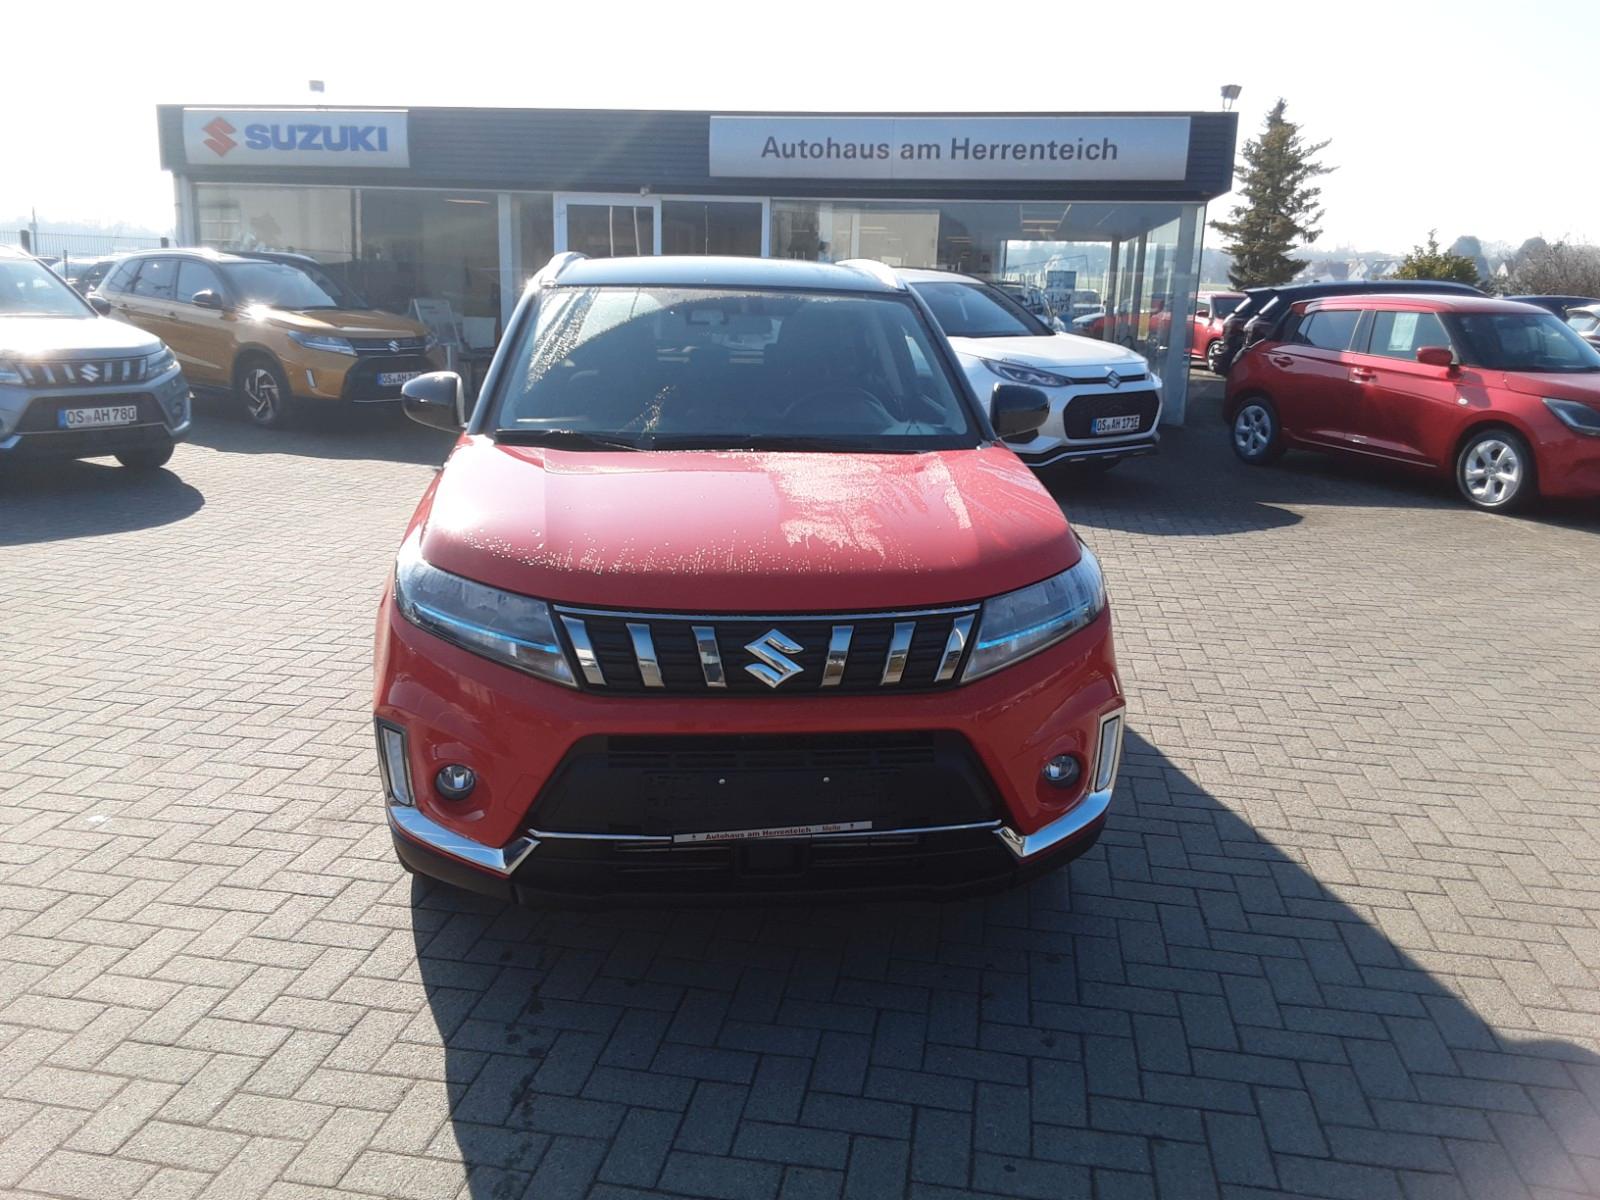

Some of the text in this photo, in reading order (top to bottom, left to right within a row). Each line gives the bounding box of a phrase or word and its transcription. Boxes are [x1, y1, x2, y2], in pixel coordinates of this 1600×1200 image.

[245, 124, 388, 152] SUZUKI
[761, 136, 1118, 161] Autohaus am Herrenteich
[67, 410, 85, 424] OS
[94, 409, 110, 422] AH
[1097, 419, 1106, 431] OS
[1112, 418, 1121, 429] AH
[705, 832, 745, 841] Autohaus
[762, 826, 812, 837] Herrenteich
